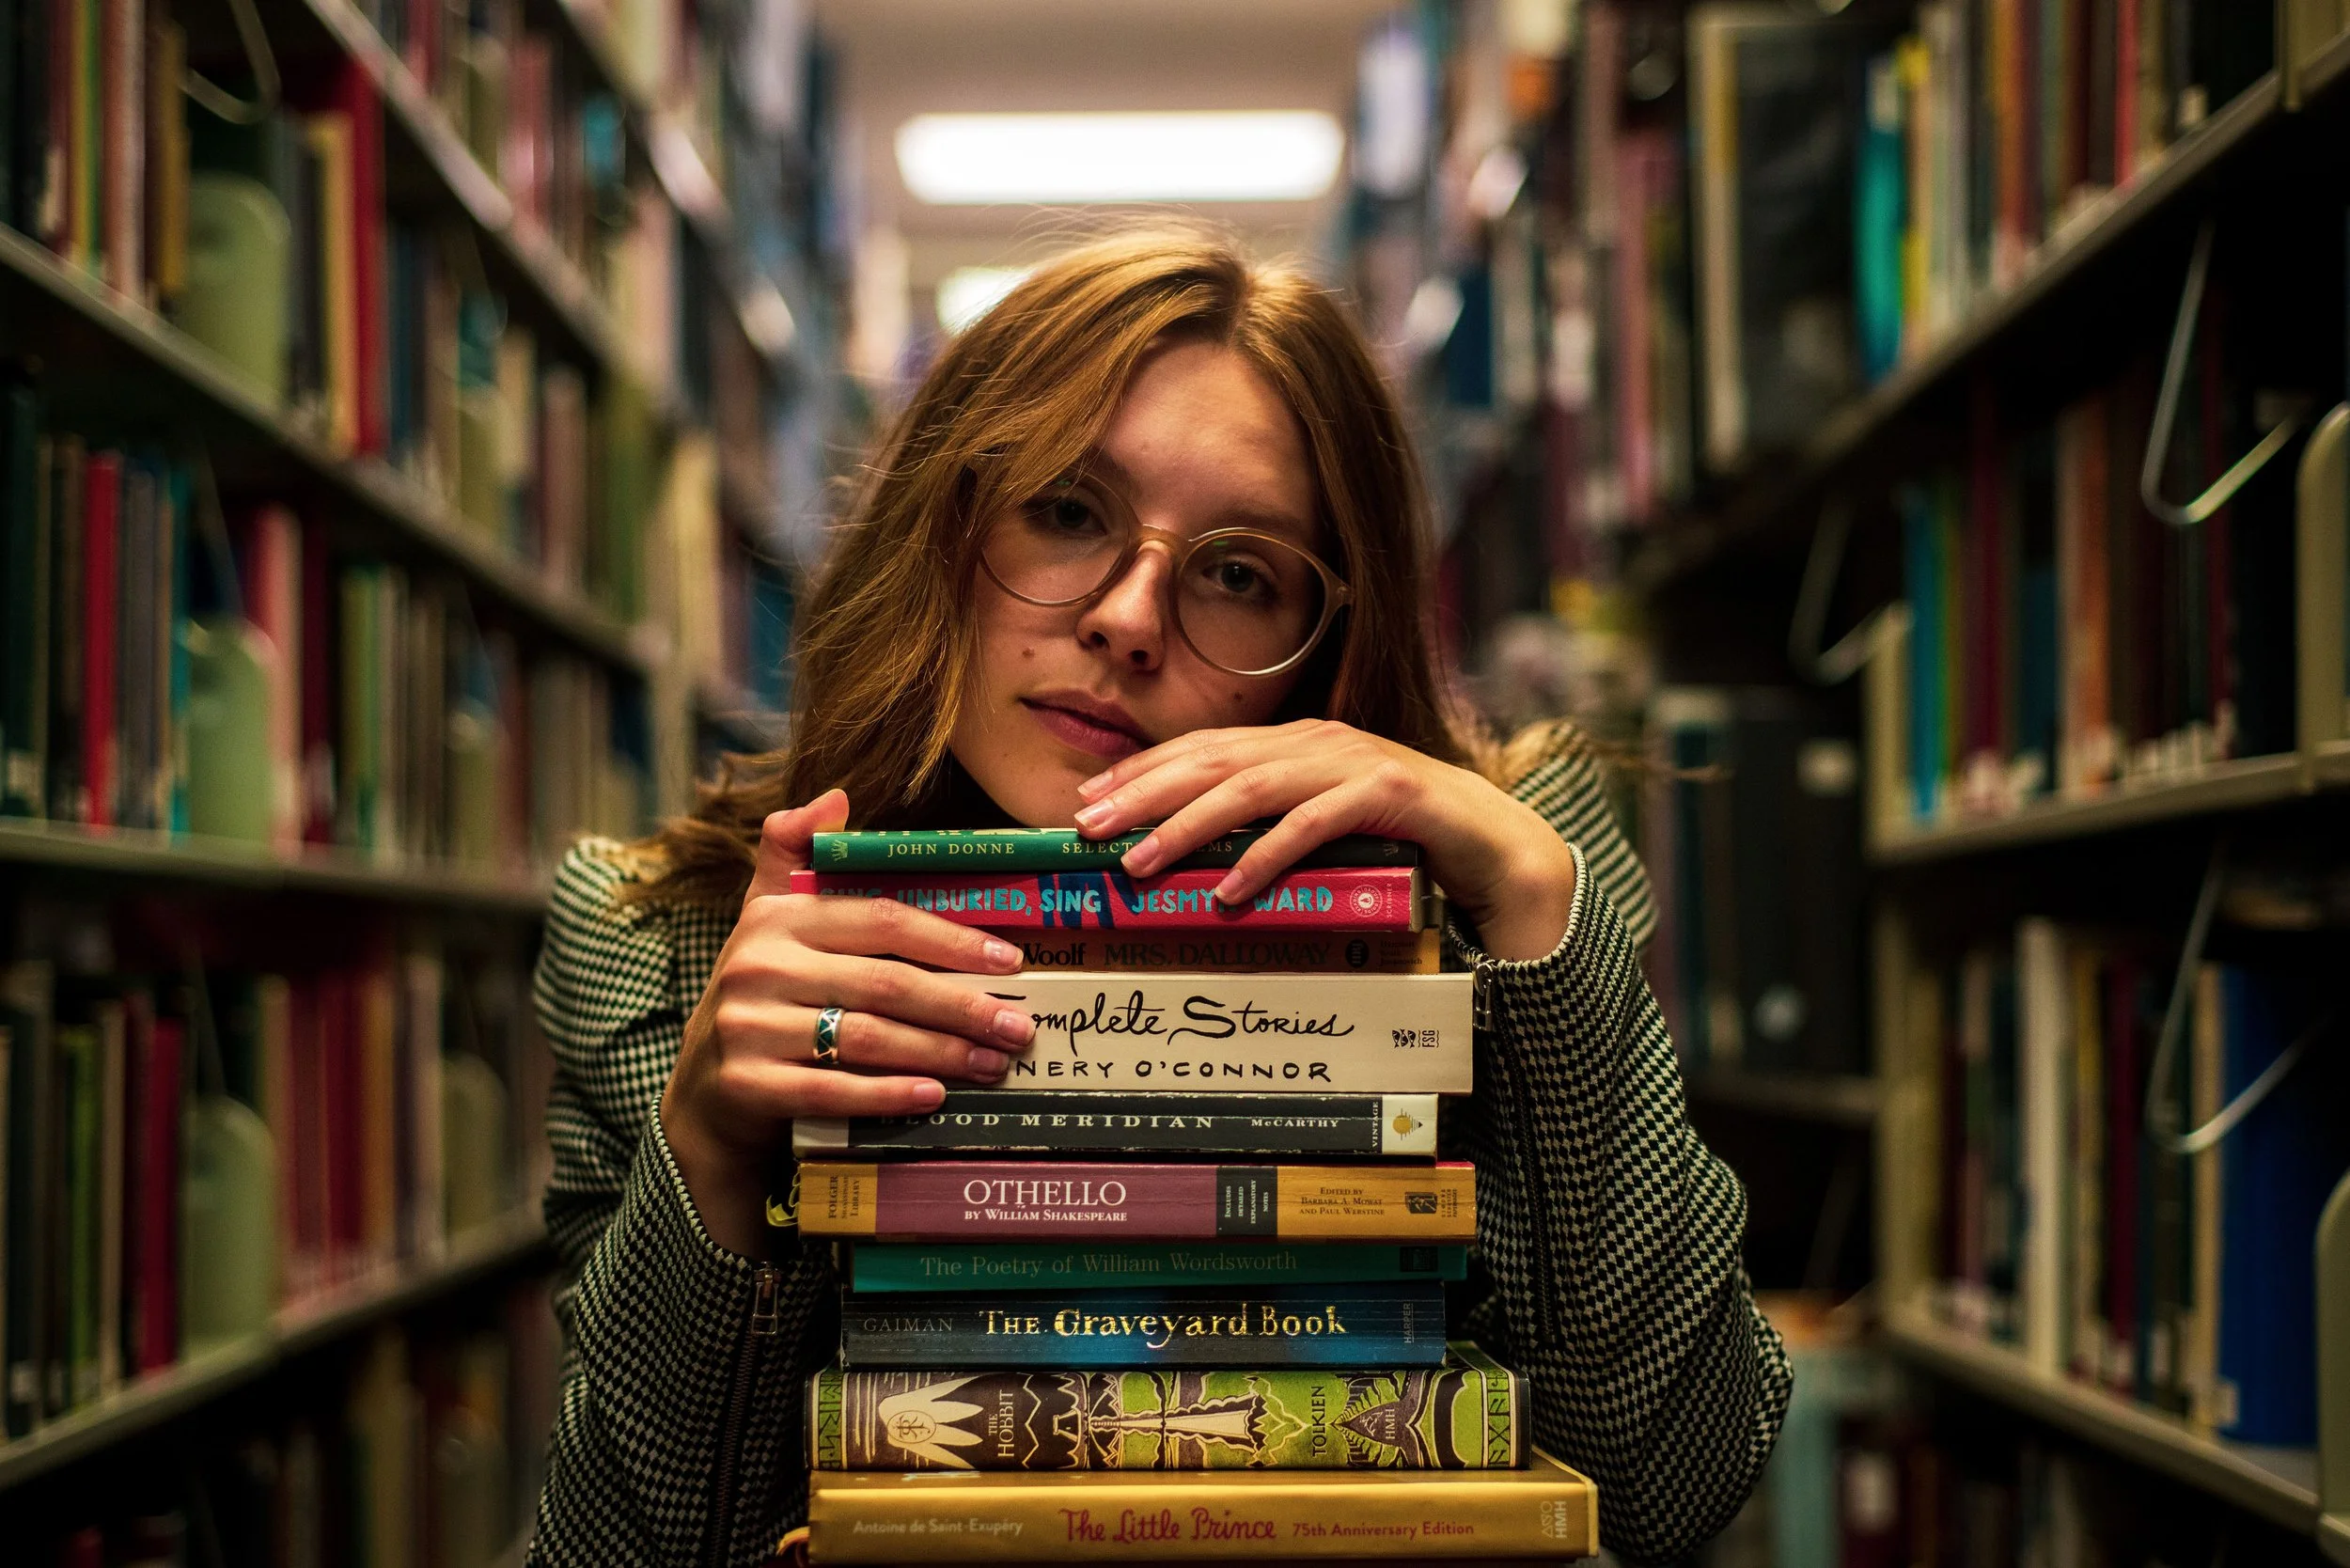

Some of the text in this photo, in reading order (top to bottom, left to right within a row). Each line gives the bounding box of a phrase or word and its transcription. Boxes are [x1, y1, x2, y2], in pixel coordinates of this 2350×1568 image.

[887, 842, 1015, 858] JOHN DONNE
[1062, 841, 1137, 855] SELECT
[1039, 888, 1102, 913] SING
[1132, 886, 1334, 914] JESMY WARD
[1023, 942, 1087, 966] Woolf
[1104, 943, 1331, 965] MRS. DALLOWAY
[985, 990, 1355, 1057] omplete Stories
[1421, 1029, 1435, 1048] FSG
[1016, 1060, 1332, 1083] NERY O'CONNOR
[1021, 1114, 1213, 1128] MERIDIAN
[1371, 1101, 1380, 1148] VINTAGE
[828, 1175, 838, 1219] FOLGER
[964, 1180, 1126, 1205] OTHELLO
[1224, 1185, 1232, 1218] INCLUDES
[1300, 1198, 1338, 1206] BARBARA
[1320, 1187, 1348, 1196] EDITED
[964, 1208, 1128, 1222] BY WILLIAM SHAKESPEARE
[1319, 1208, 1339, 1216] PAUL
[1342, 1208, 1386, 1216] WERSTINE
[920, 1251, 1298, 1277] The Poetry of William Wordsworth
[863, 1318, 954, 1332] GAIMAN
[979, 1303, 1351, 1348] THE Graveyard Book
[1402, 1302, 1412, 1343] HARPER
[988, 1413, 998, 1436] THE
[996, 1389, 1015, 1457] HOBBIT
[1311, 1385, 1327, 1457] TOLKIEN
[1385, 1408, 1397, 1440] HMH
[853, 1517, 1024, 1537] Antoine de Saint-Exupéry
[1059, 1507, 1277, 1543] The Little Prince
[1292, 1521, 1475, 1540] 75th Anniversary Edition
[1554, 1500, 1568, 1538] HMH
